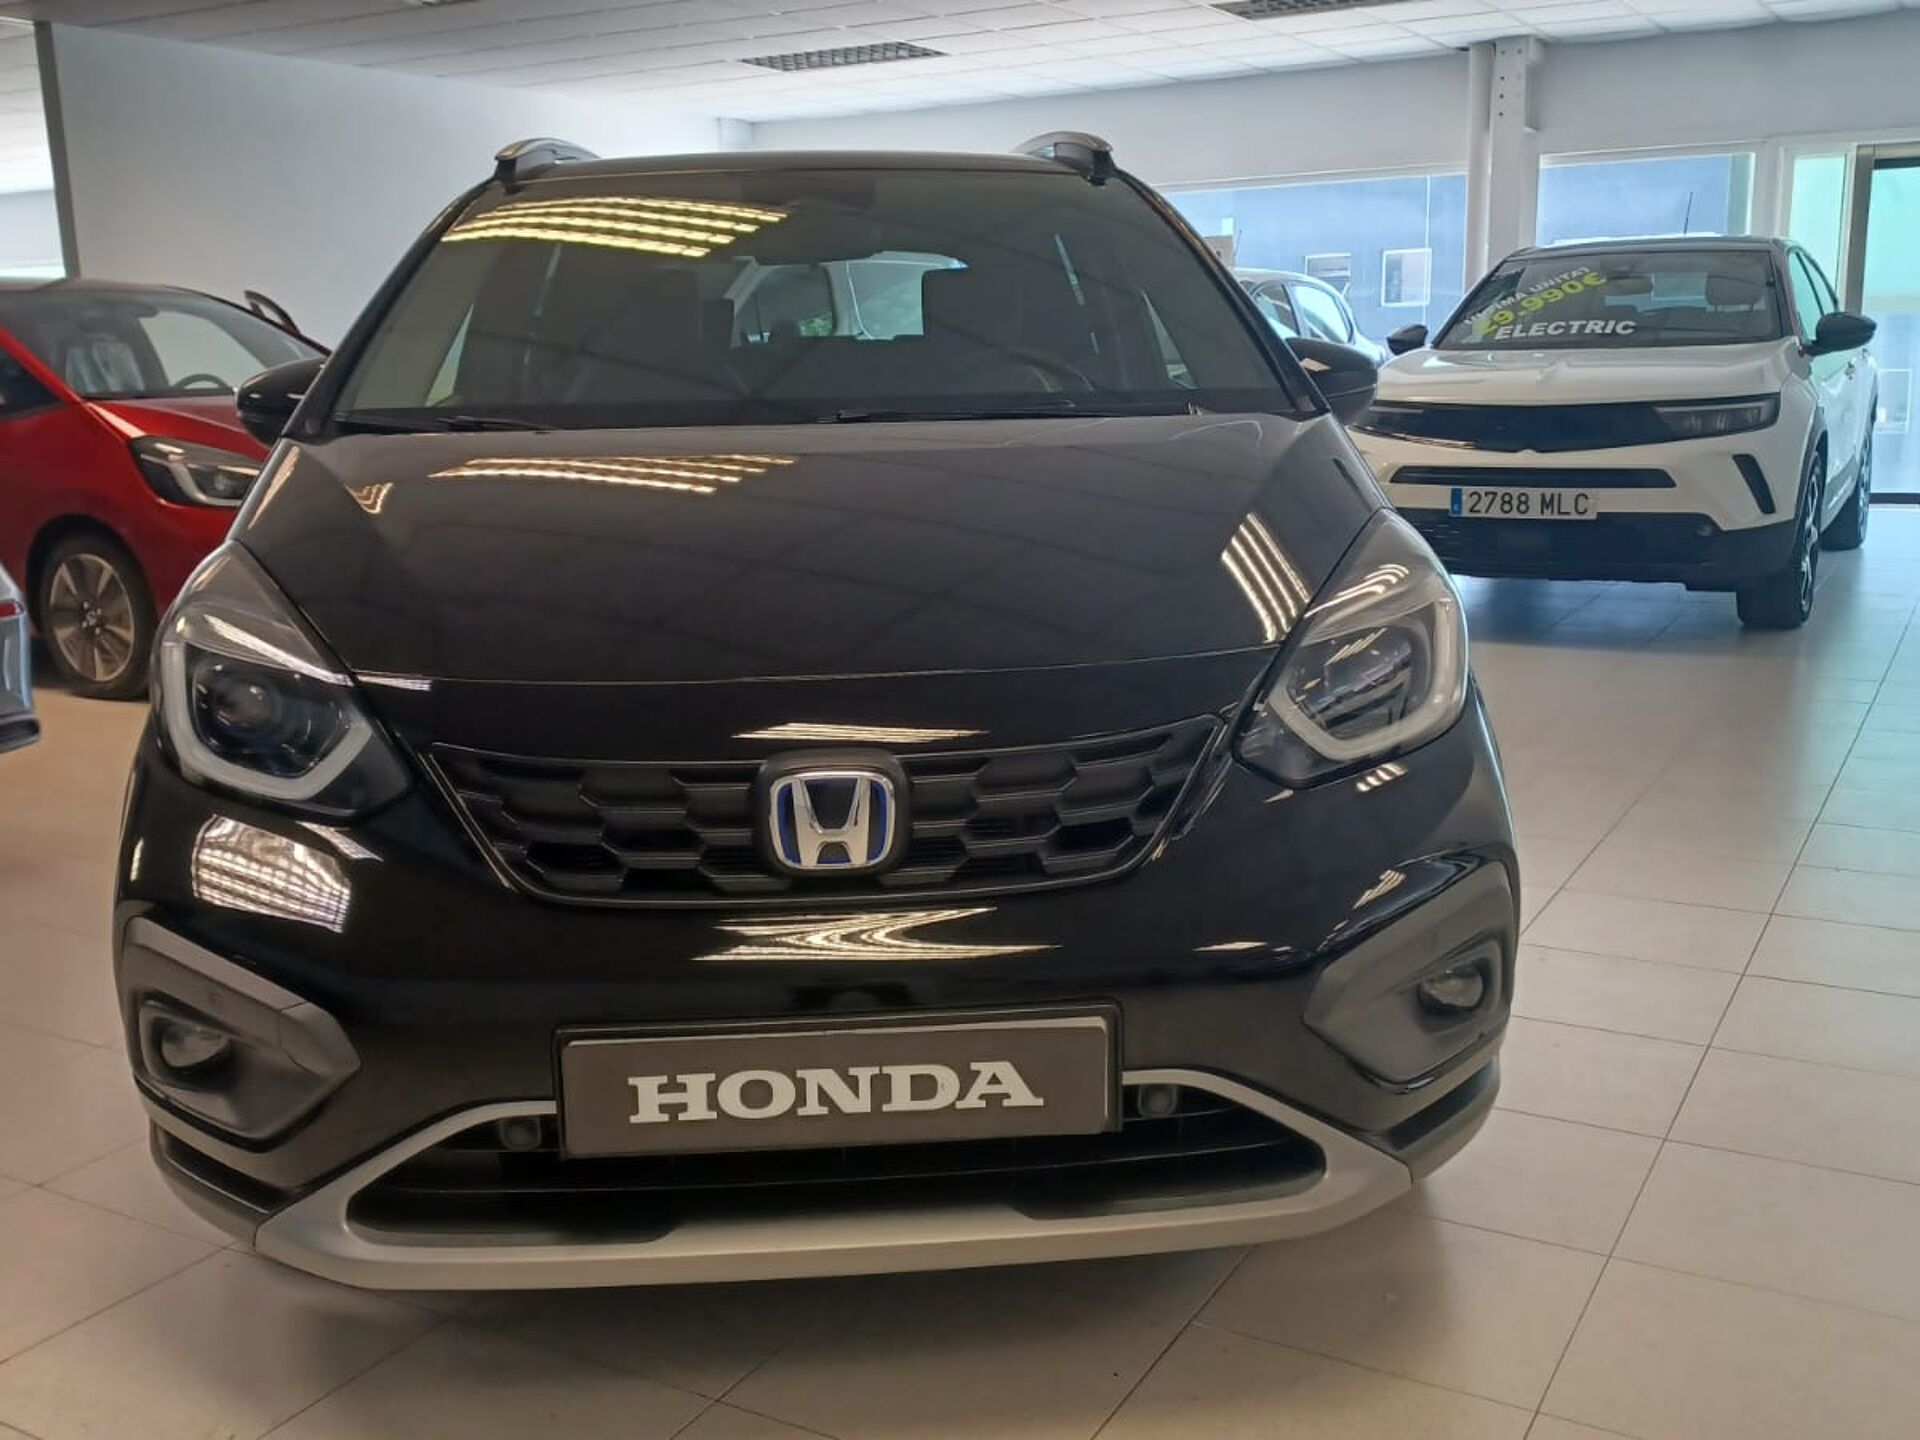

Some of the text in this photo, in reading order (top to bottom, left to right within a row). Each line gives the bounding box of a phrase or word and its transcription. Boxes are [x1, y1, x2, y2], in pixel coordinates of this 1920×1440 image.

[1494, 319, 1637, 339] ELECTRIC
[1469, 490, 1590, 516] 2788 MLC
[628, 1060, 1045, 1124] HONDA
